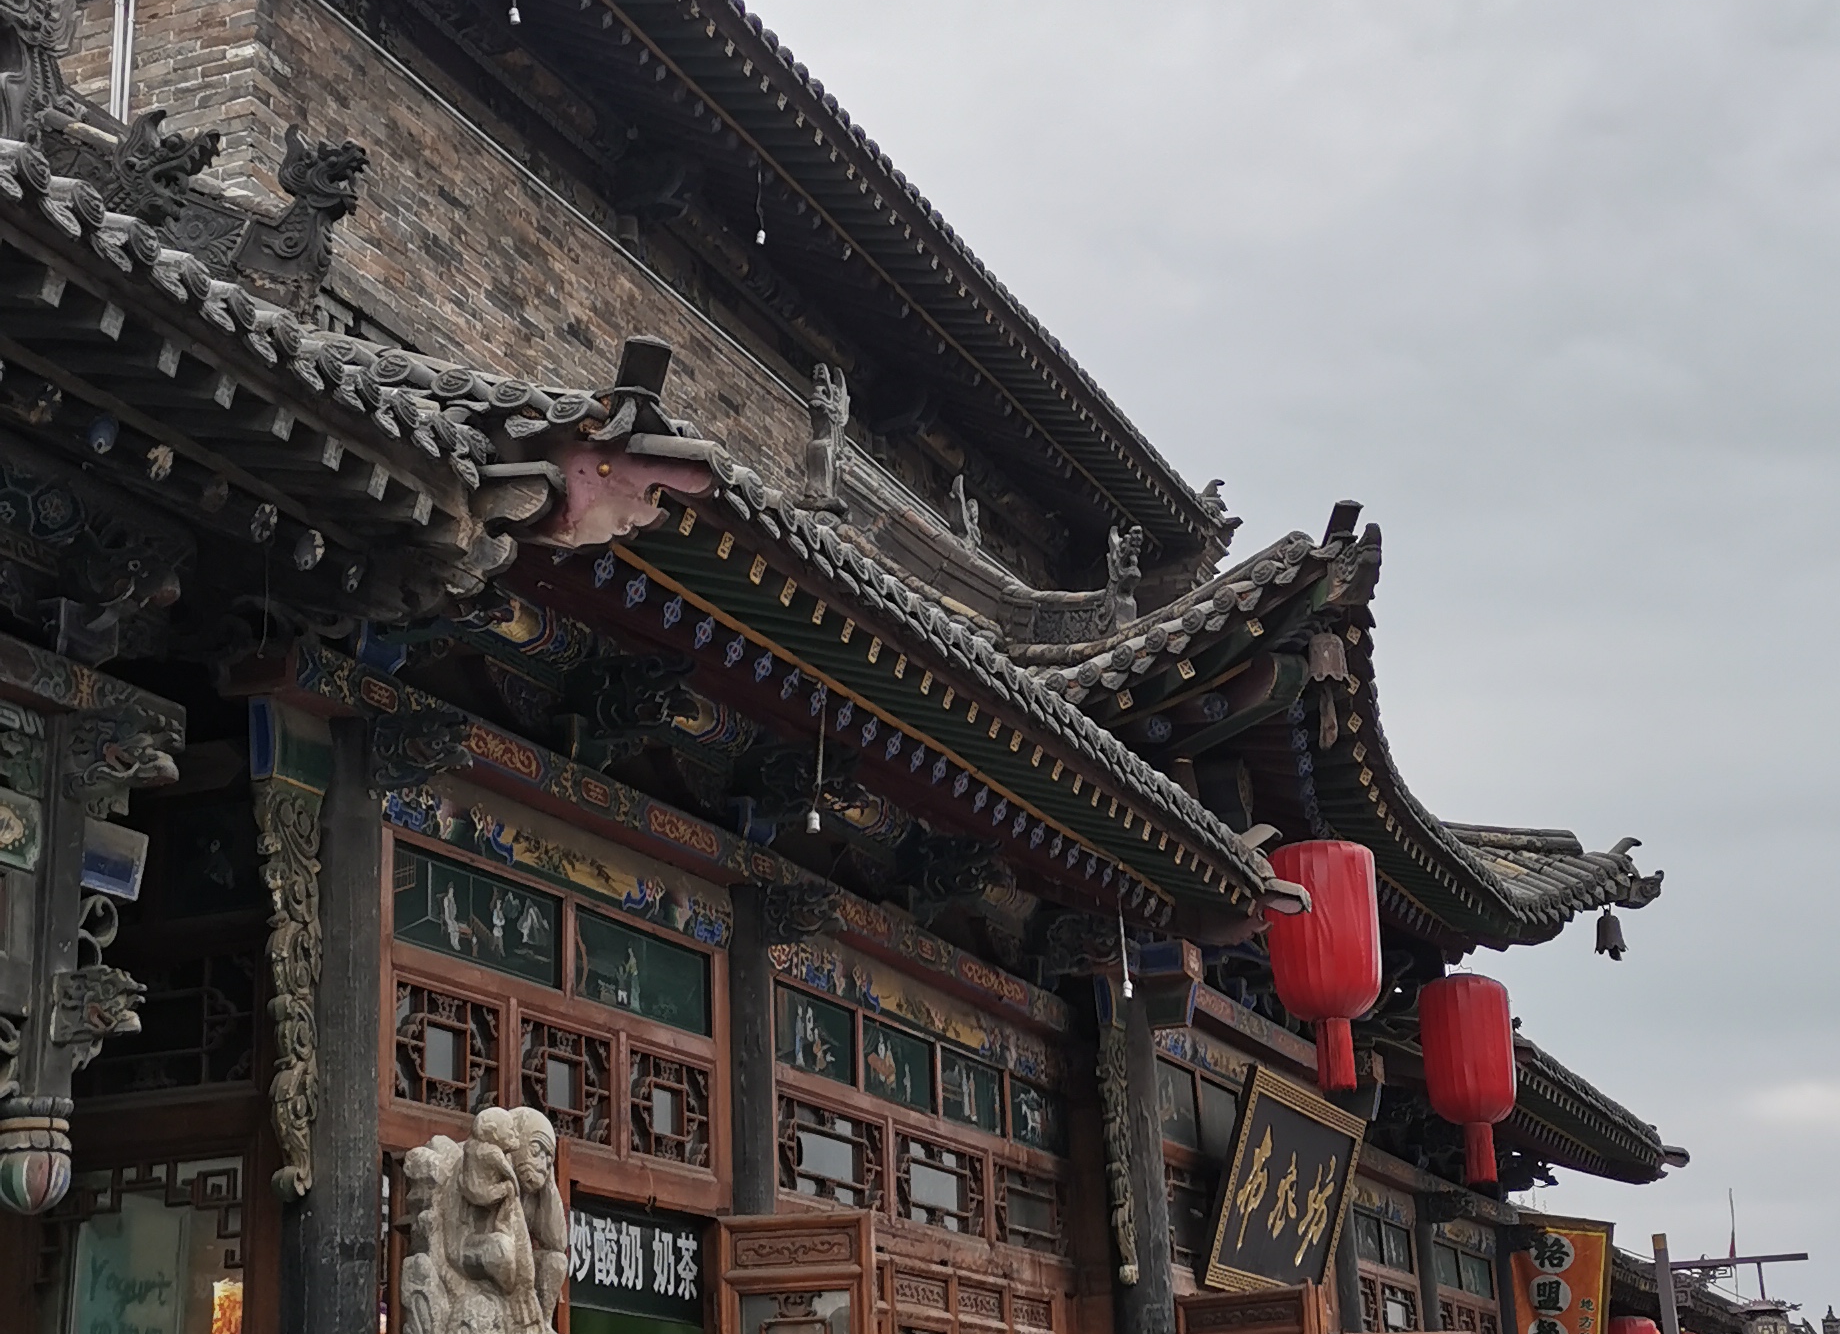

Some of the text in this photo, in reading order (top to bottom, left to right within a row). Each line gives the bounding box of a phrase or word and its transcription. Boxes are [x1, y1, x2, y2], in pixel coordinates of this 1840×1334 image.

[89, 1253, 172, 1319] Yogurt
[569, 1210, 699, 1301] 炒酸奶 奶茶
